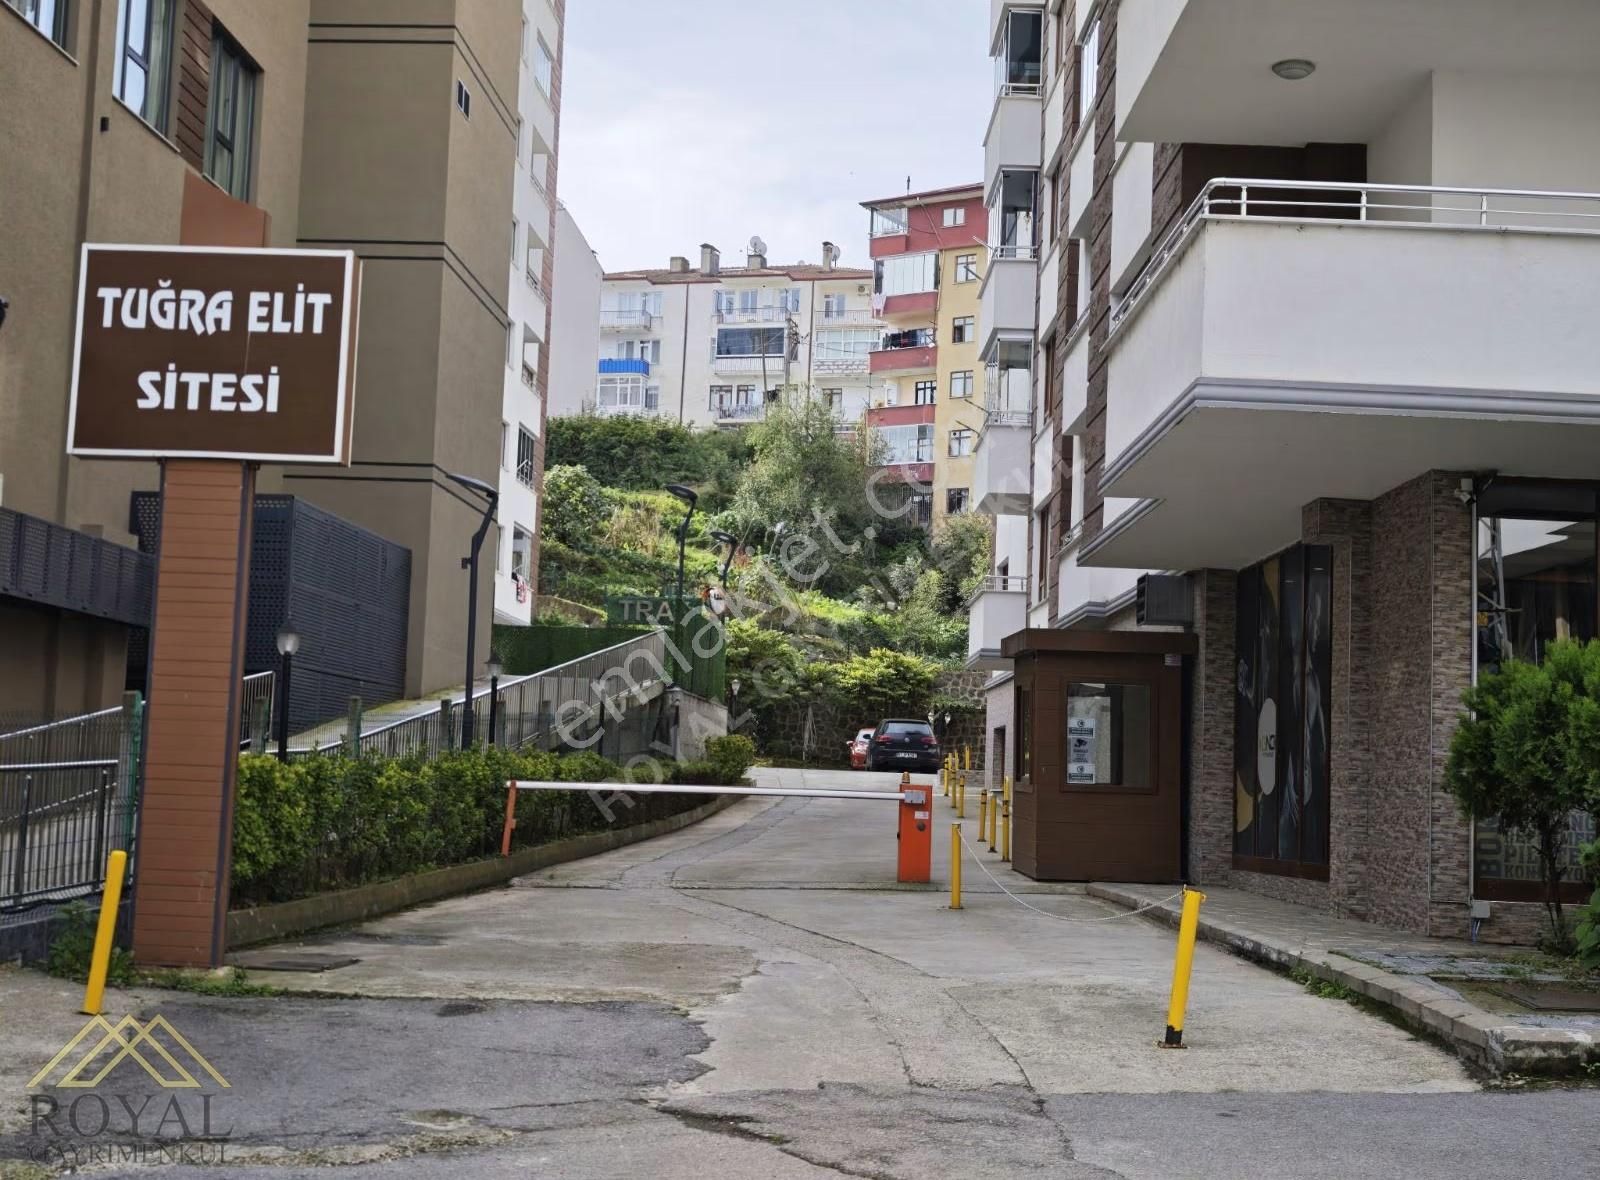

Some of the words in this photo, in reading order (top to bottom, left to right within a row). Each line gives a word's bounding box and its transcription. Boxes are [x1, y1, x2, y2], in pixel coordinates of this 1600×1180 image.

[97, 279, 233, 335] TUĞRA
[248, 283, 332, 334] ELİT
[136, 363, 280, 412] SİTESİ
